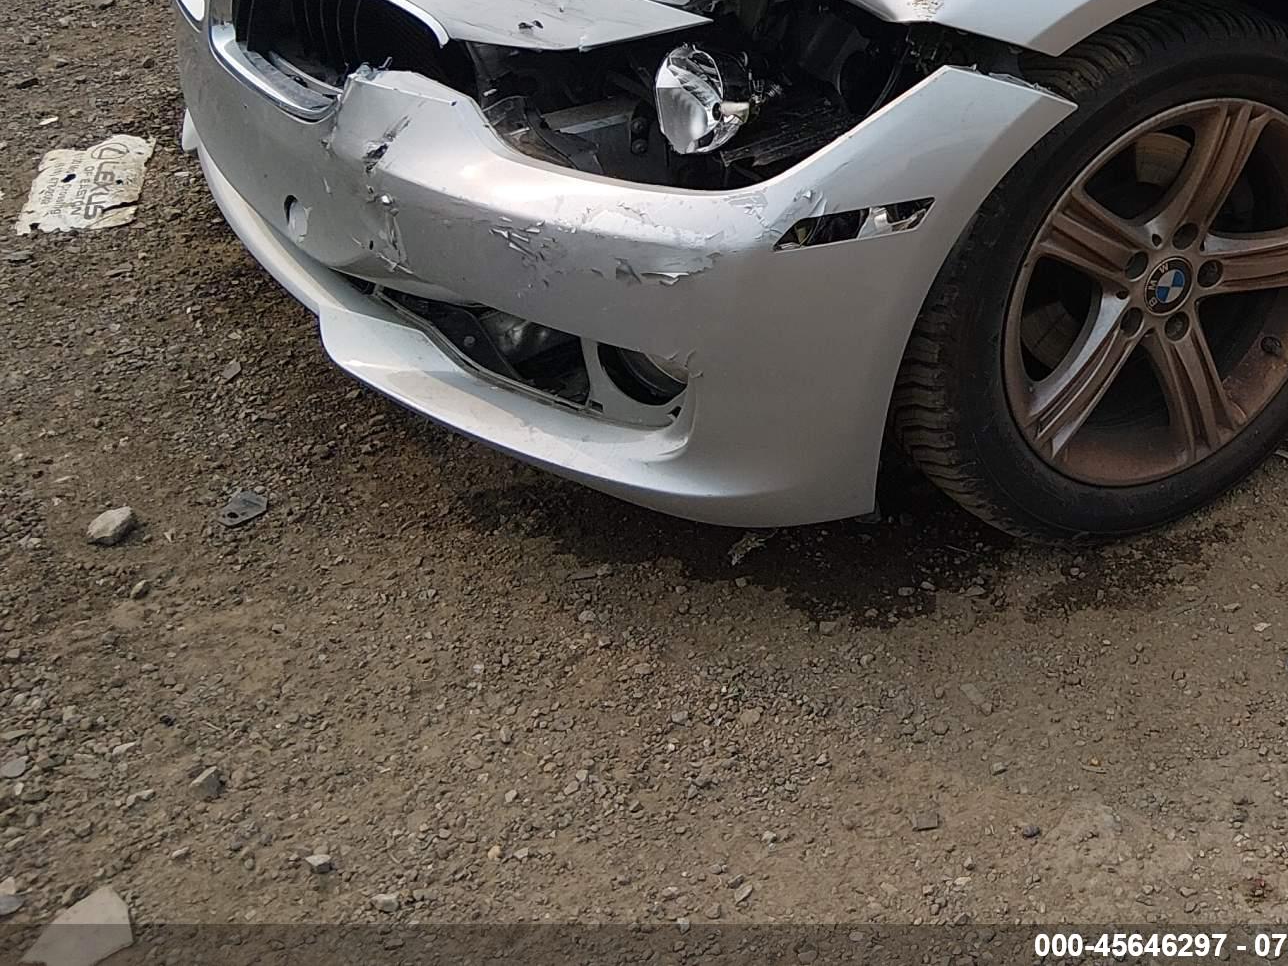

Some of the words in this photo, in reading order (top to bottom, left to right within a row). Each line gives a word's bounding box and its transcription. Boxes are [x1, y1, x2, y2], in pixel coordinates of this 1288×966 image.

[84, 166, 95, 176] OF
[71, 180, 89, 216] EASTON
[84, 161, 120, 220] LEXUS
